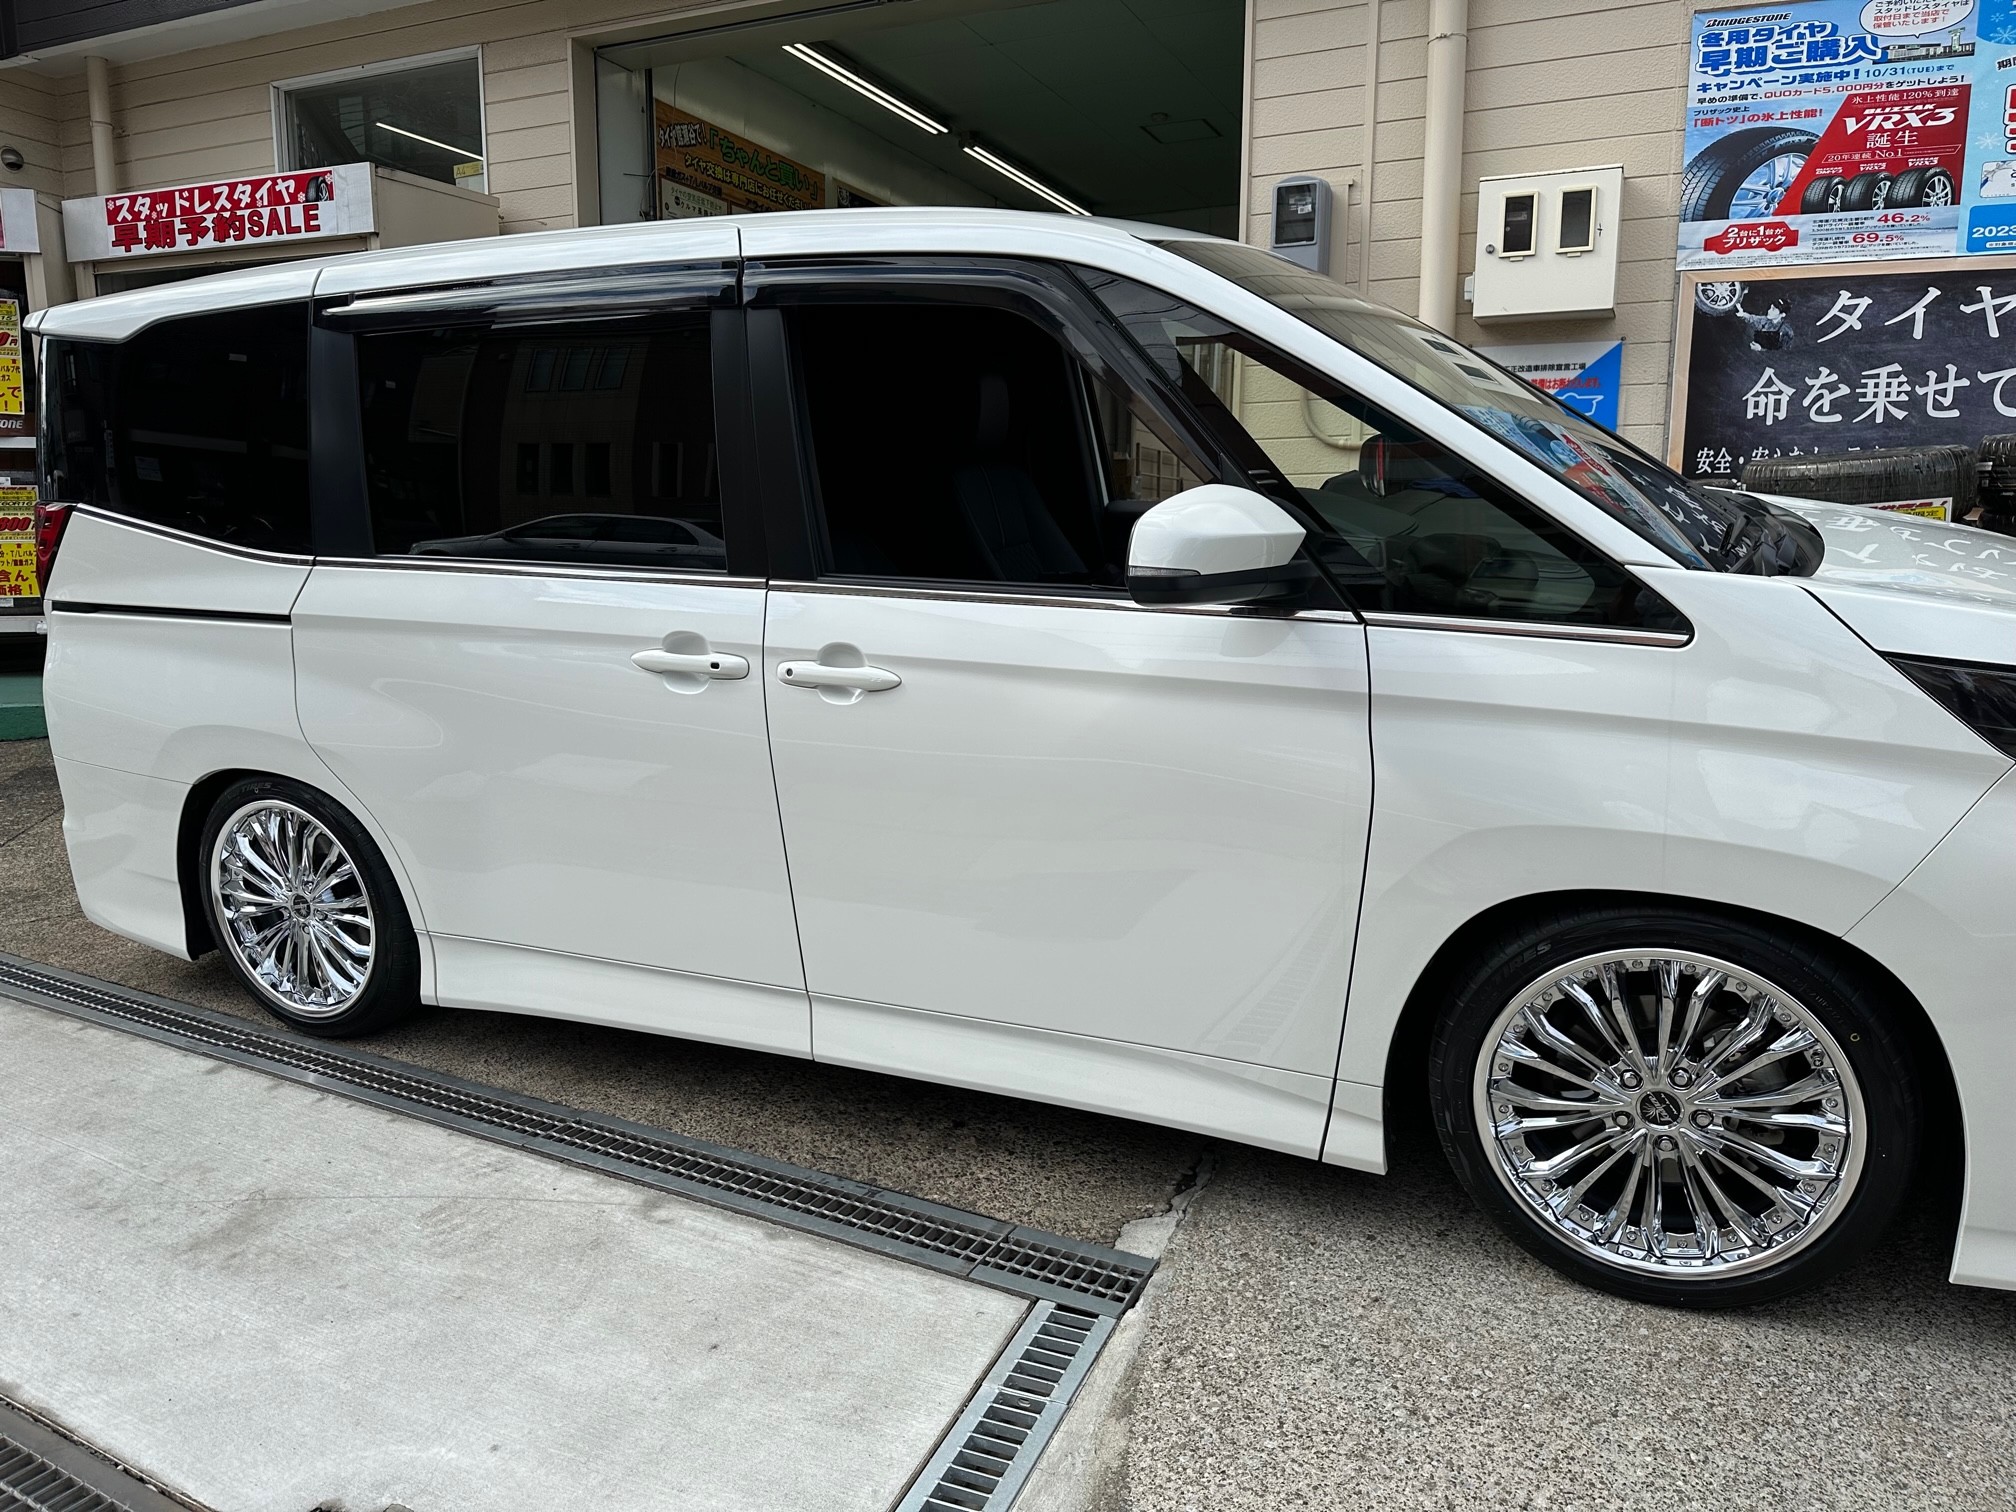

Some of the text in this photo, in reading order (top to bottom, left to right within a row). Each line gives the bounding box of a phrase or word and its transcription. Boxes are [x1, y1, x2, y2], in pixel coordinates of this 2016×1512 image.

[1873, 9, 1950, 21] 取付日まで当店で
[1874, 0, 1970, 15] スタッドレスタイヤは
[1704, 13, 1792, 28] BRIDGESTONE
[1701, 22, 1831, 48] 冬用タイヤ
[1699, 35, 1879, 71] 早期ご購入
[1696, 68, 1860, 93] キャンペーン実施中!
[1851, 93, 1900, 105] 氷上性能
[1903, 90, 1933, 100] 120%
[1863, 103, 1937, 115] BLIZZAK
[1842, 106, 1959, 135] VRX3
[1866, 130, 1919, 149] 誕生
[115, 177, 296, 222] スタッドレスタイヤ
[1877, 212, 1931, 224] 46.2%
[111, 203, 321, 252] 早期予約SALE
[1727, 225, 1786, 238] 2台に1台が
[1722, 235, 1786, 248] ブリザック
[1852, 232, 1905, 244] 69.5%
[0, 419, 23, 429] ONE
